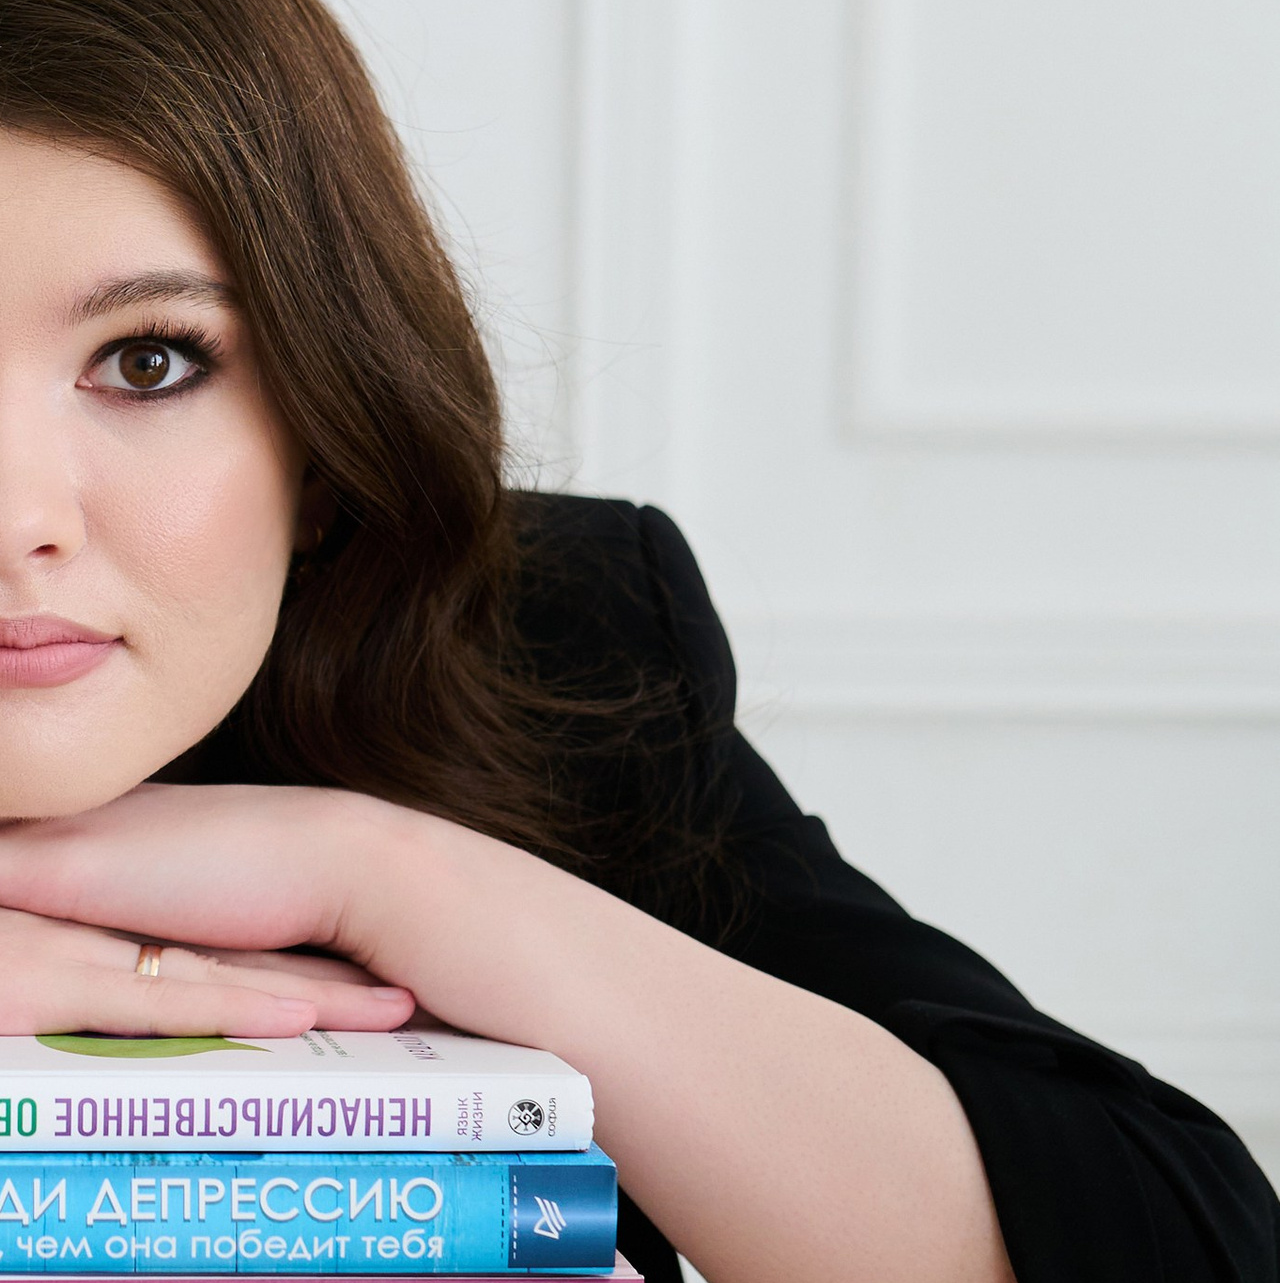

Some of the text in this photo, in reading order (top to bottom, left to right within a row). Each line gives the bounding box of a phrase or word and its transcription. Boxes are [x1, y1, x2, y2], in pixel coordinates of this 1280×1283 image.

[54, 1097, 432, 1138] НЕНАСИЛЬСТВЕННОЕ
[457, 1097, 469, 1136] ЯЗЫК
[470, 1091, 484, 1142] ЖИЗНИ
[86, 1177, 444, 1225] ДЕПРЕССИЮ
[16, 1235, 93, 1259] чем
[104, 1232, 177, 1259] она
[190, 1228, 351, 1262] победит
[360, 1228, 445, 1259] тебя
